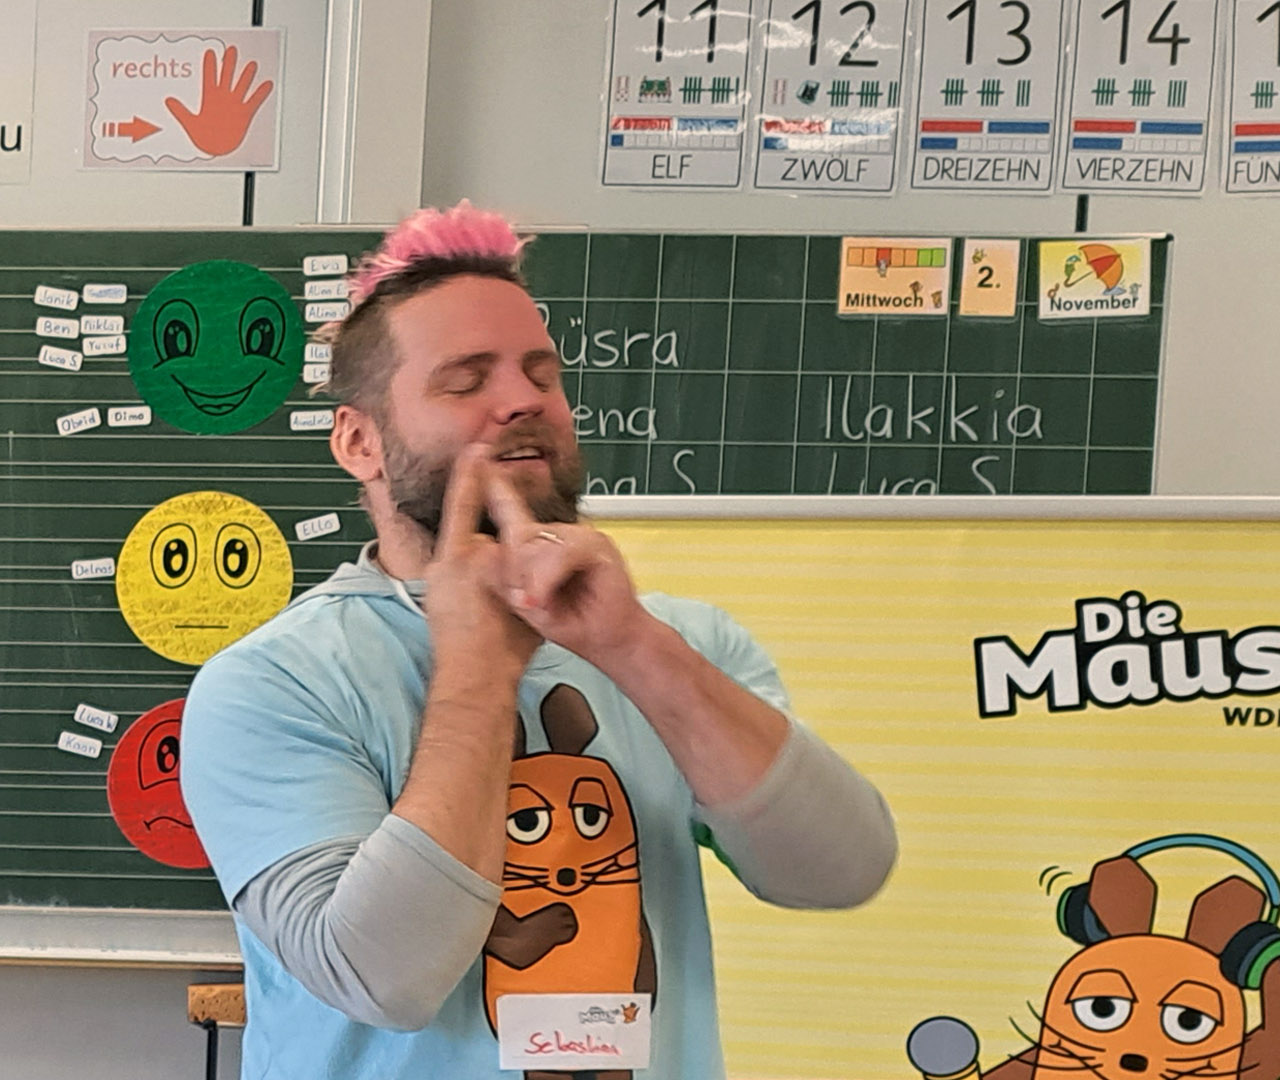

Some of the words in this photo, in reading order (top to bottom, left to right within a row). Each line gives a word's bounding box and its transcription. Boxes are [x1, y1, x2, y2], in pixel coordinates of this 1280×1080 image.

[637, 0, 718, 63] 11
[792, 0, 880, 66] 12
[945, 0, 1032, 66] 13
[1100, 0, 1191, 66] 14
[112, 54, 193, 79] rechts
[651, 155, 692, 180] ELF
[780, 155, 870, 182] ZWÖLF
[922, 156, 1042, 183] DREIZEHN
[1076, 157, 1193, 184] VIERZEHN
[976, 266, 1003, 290] 2.
[844, 292, 925, 309] Mittwoch
[1048, 294, 1139, 313] November
[43, 319, 71, 334] Ben
[824, 374, 1044, 443] Ilakkia
[571, 404, 658, 441] ena
[1080, 595, 1180, 643] Die
[980, 629, 1280, 714] Maus
[1222, 706, 1280, 727] WD
